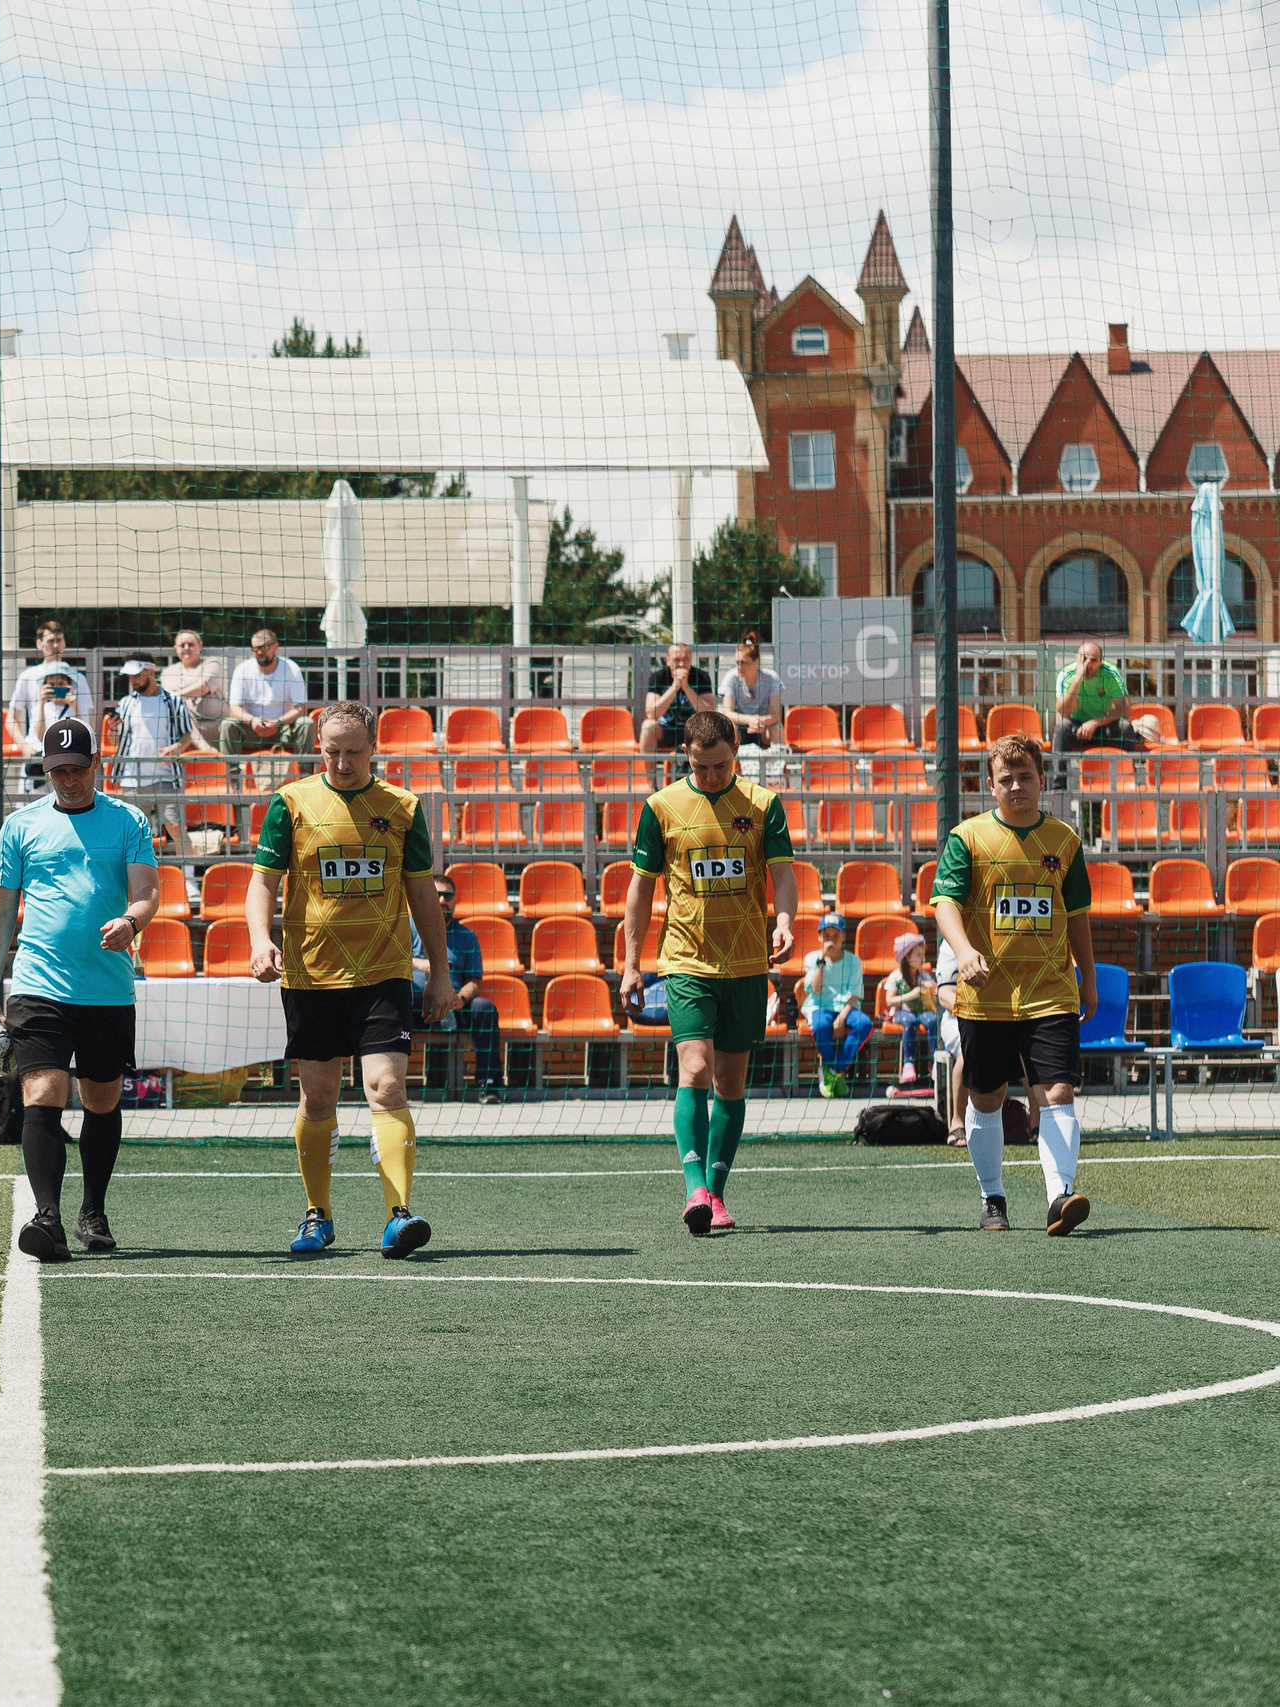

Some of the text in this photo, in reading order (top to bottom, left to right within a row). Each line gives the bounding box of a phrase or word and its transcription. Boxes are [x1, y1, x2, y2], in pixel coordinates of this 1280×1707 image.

[787, 664, 850, 679] СЕКТОР
[324, 860, 381, 877] ADS
[694, 859, 744, 877] ADS
[999, 898, 1050, 915] ADS
